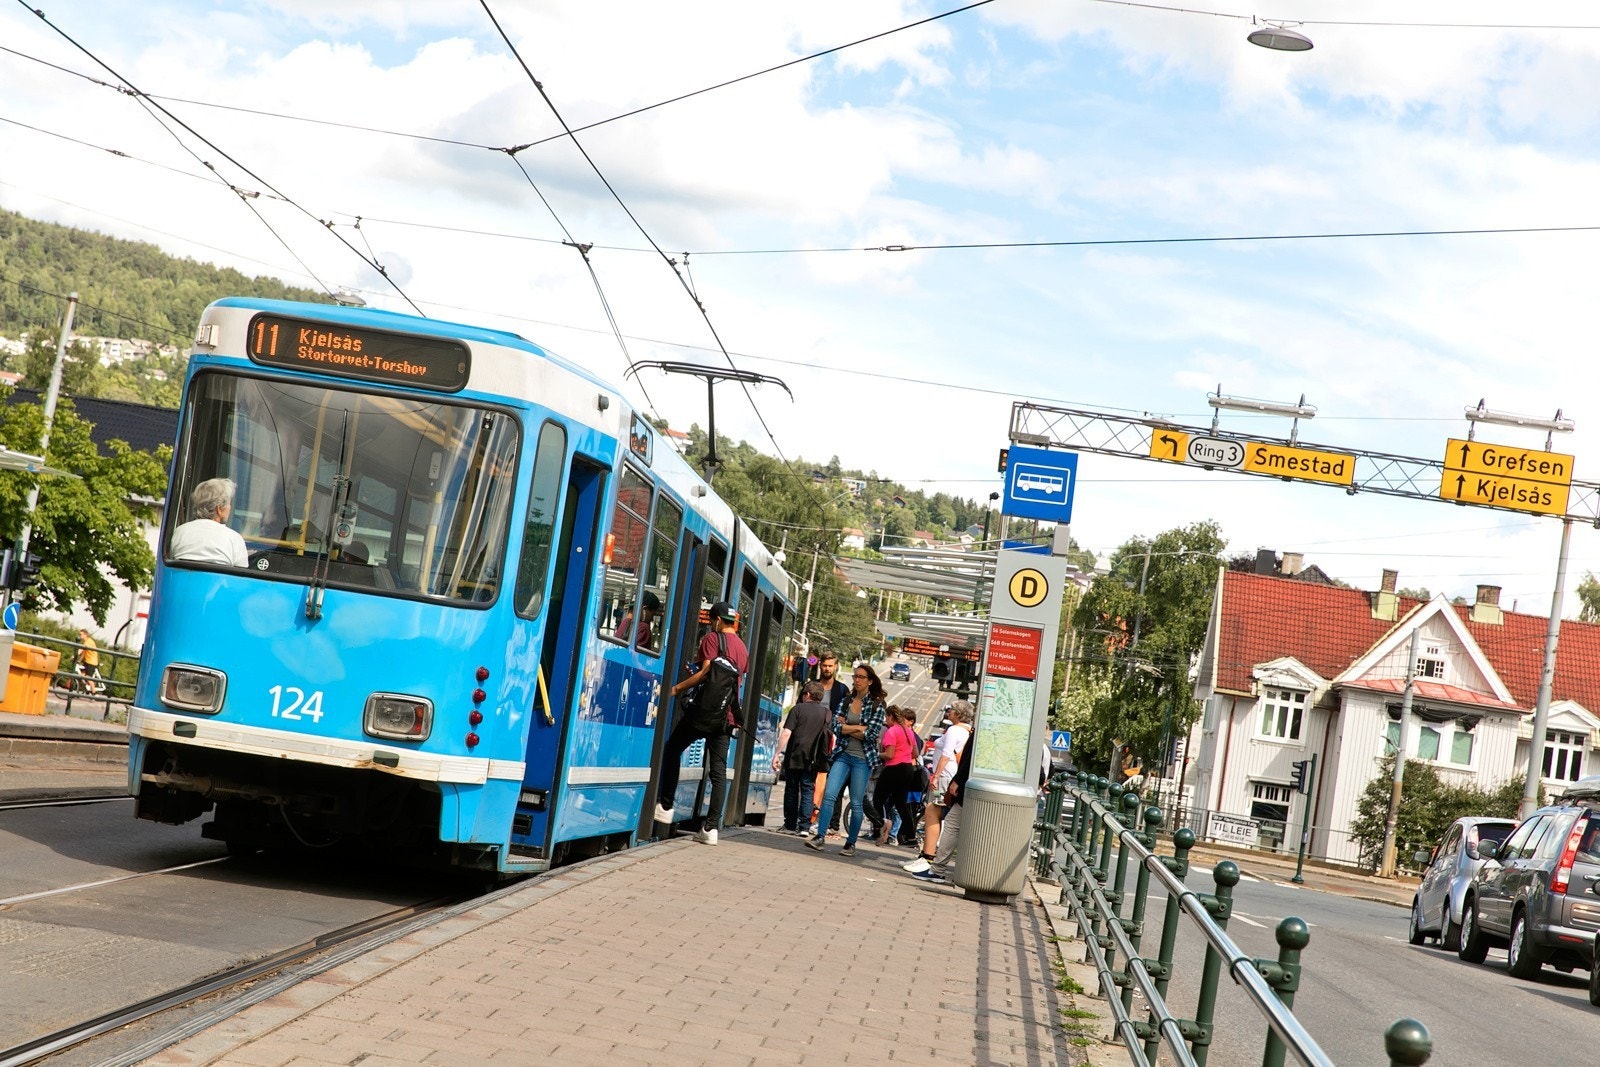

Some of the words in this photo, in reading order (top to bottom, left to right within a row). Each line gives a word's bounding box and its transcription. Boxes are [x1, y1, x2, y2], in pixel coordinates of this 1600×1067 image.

[256, 322, 279, 356] 11
[299, 328, 363, 352] Kjelsås
[298, 346, 427, 376] Stortorvet-Torshov
[1194, 443, 1224, 462] Ring
[1227, 447, 1238, 462] 3
[1254, 447, 1345, 477] Smestad
[1482, 448, 1564, 477] Grefsen
[1476, 479, 1552, 506] Kjelsås
[1020, 576, 1038, 598] D
[268, 685, 324, 723] 124
[1213, 822, 1228, 833] TIL
[1230, 825, 1252, 837] LEIE
